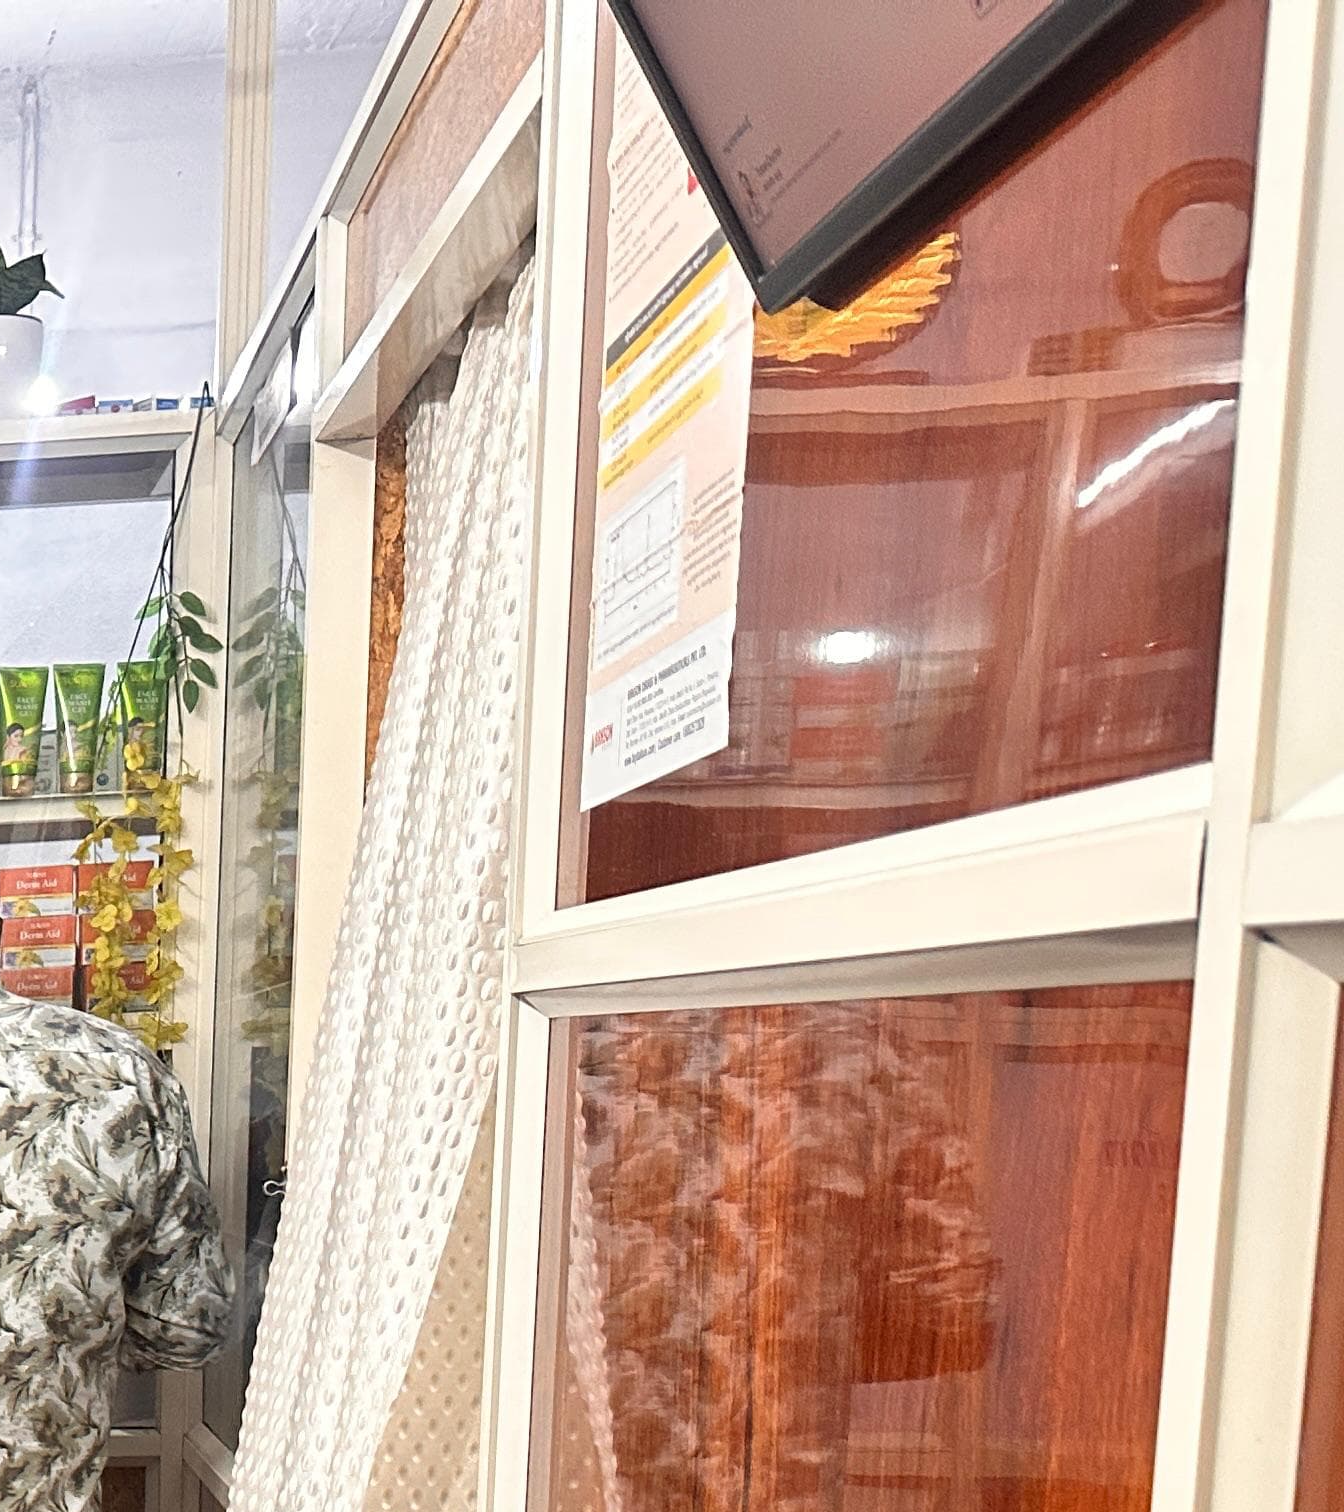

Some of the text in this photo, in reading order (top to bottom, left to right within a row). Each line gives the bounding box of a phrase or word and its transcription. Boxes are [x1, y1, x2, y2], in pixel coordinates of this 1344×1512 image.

[16, 879, 57, 889] Derm Aid
[19, 930, 60, 940] Derm Aid
[17, 981, 58, 992] Derm Aid
